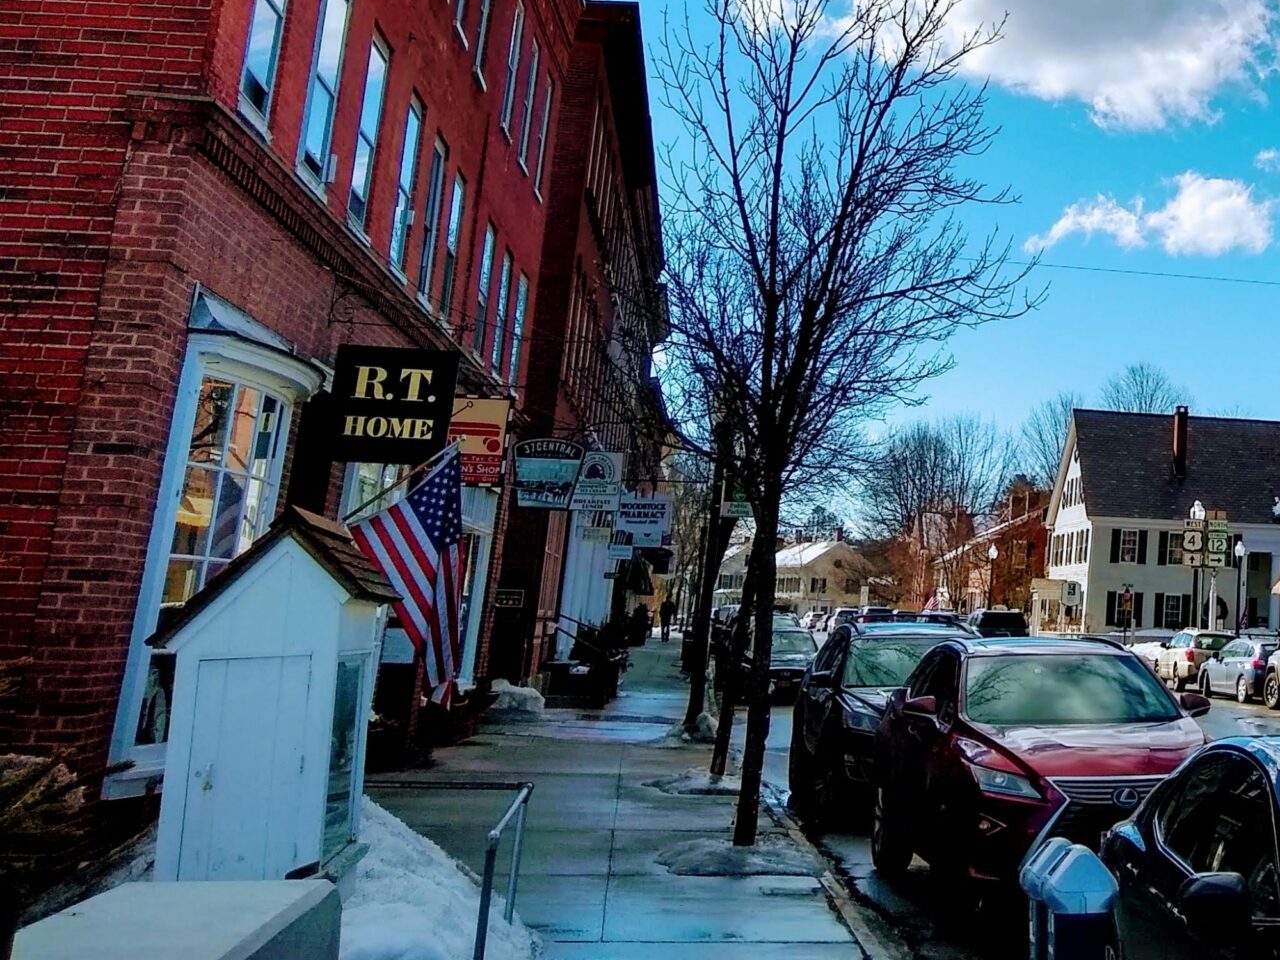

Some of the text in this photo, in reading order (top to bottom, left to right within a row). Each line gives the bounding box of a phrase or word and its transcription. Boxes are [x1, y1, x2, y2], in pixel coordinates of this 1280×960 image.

[350, 365, 436, 402] R.T.
[342, 414, 434, 440] HOME
[476, 463, 500, 474] SHOP
[620, 511, 665, 519] PHARMACY
[1188, 535, 1196, 546] 4
[1212, 540, 1224, 551] 12
